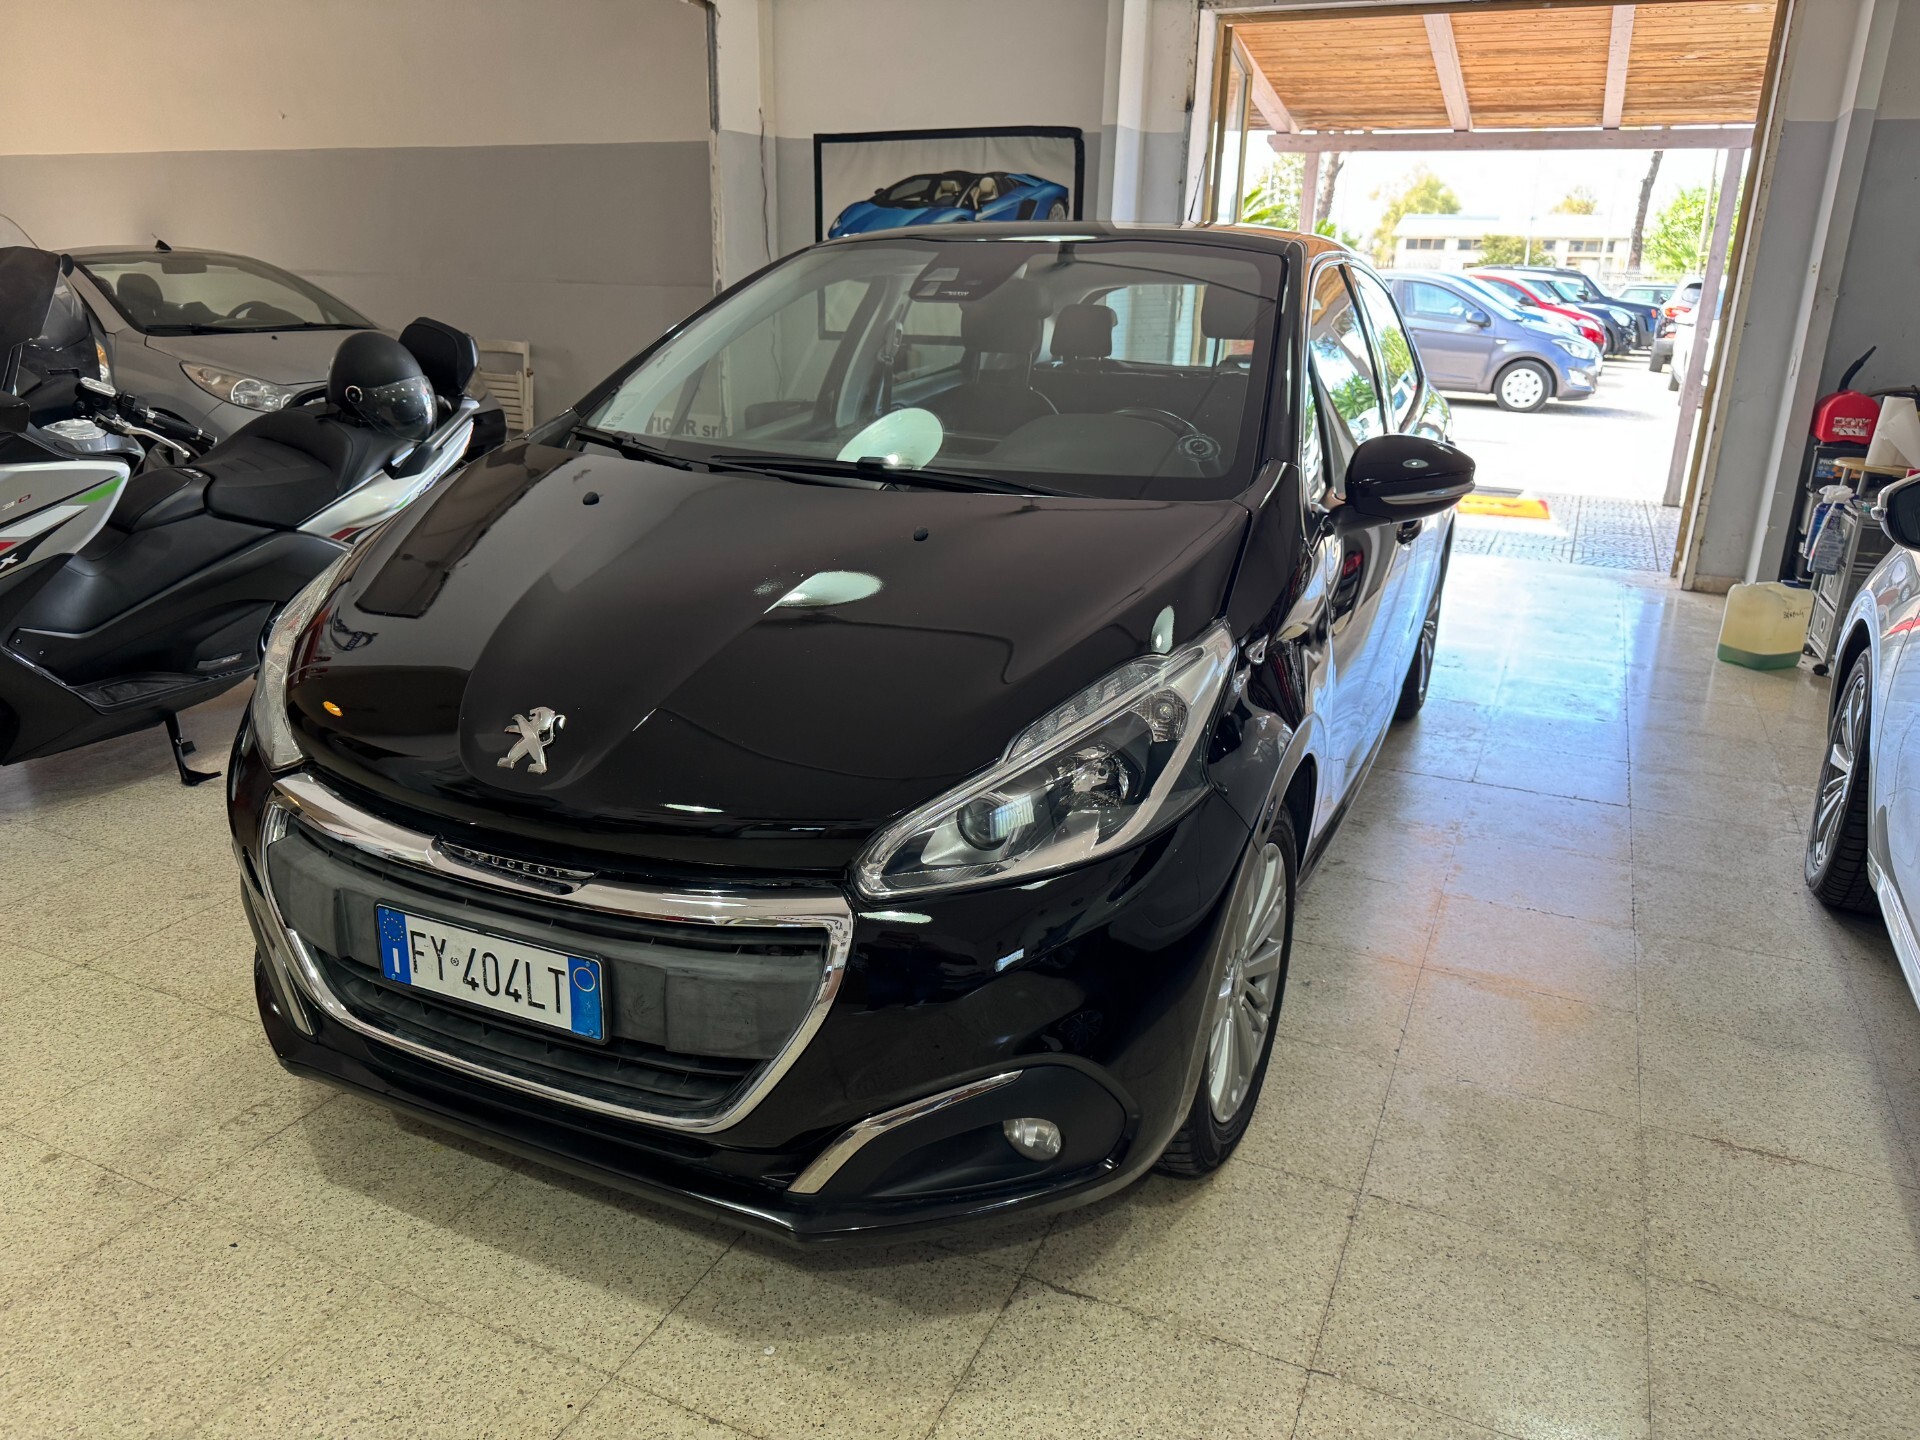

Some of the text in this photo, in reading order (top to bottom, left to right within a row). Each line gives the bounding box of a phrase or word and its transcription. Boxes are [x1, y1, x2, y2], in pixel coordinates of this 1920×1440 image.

[464, 849, 562, 877] PEUGEOT
[409, 930, 566, 1014] FY 404LT
